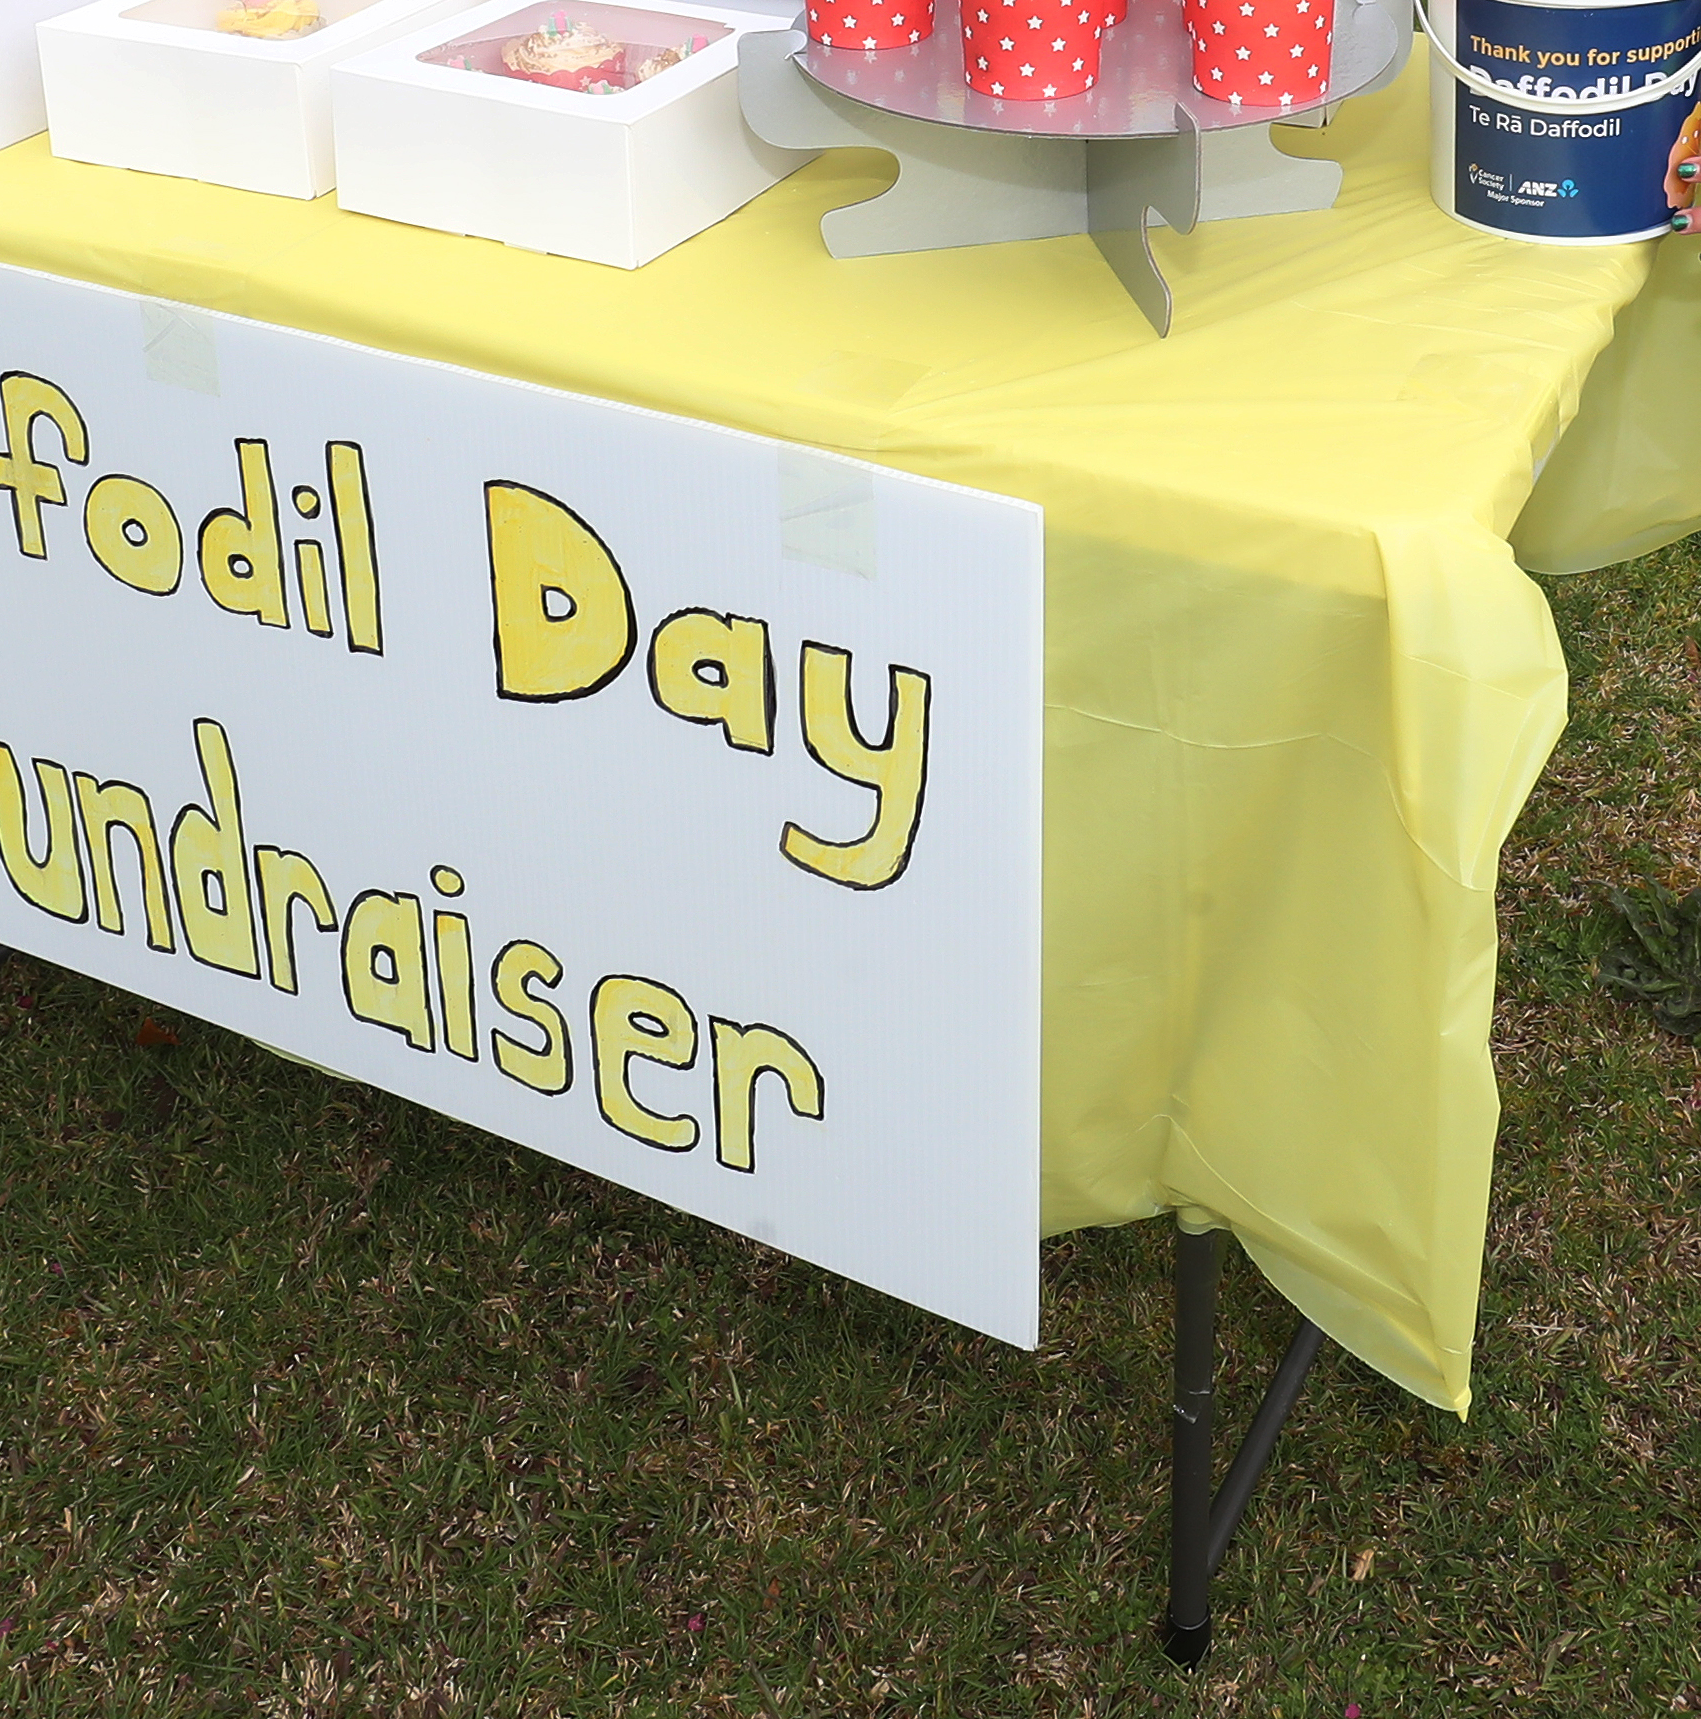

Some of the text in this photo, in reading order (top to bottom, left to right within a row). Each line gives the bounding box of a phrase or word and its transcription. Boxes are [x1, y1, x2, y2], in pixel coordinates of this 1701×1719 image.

[1470, 34, 1531, 64] Thank
[1537, 51, 1580, 69] you
[1587, 48, 1621, 66] for
[1469, 104, 1491, 126] Te
[1530, 118, 1621, 138] Daffodil
[1487, 190, 1545, 208] Major Sponsor
[1517, 180, 1558, 197] ANZ
[485, 479, 931, 891] Day
